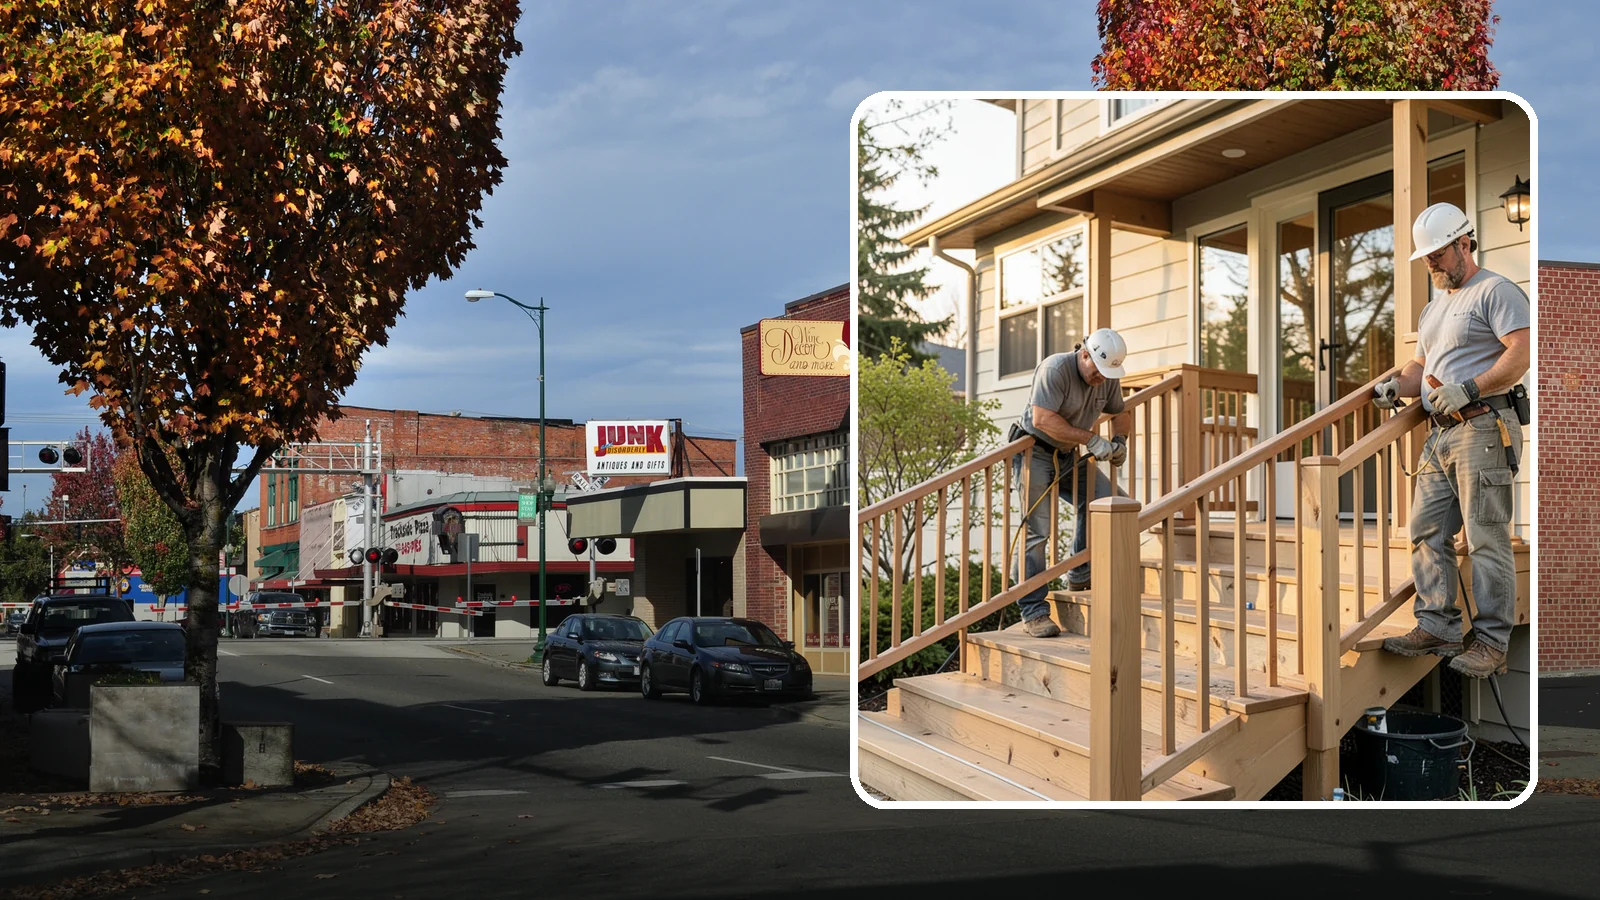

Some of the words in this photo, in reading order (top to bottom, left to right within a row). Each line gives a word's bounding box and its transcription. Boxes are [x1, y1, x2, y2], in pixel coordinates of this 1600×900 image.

[791, 325, 823, 344] Wine
[596, 425, 664, 457] JUNK
[597, 462, 627, 470] ANTIQUES
[631, 461, 643, 469] AND
[647, 461, 665, 469] GIFTS
[415, 519, 429, 535] Pizza
